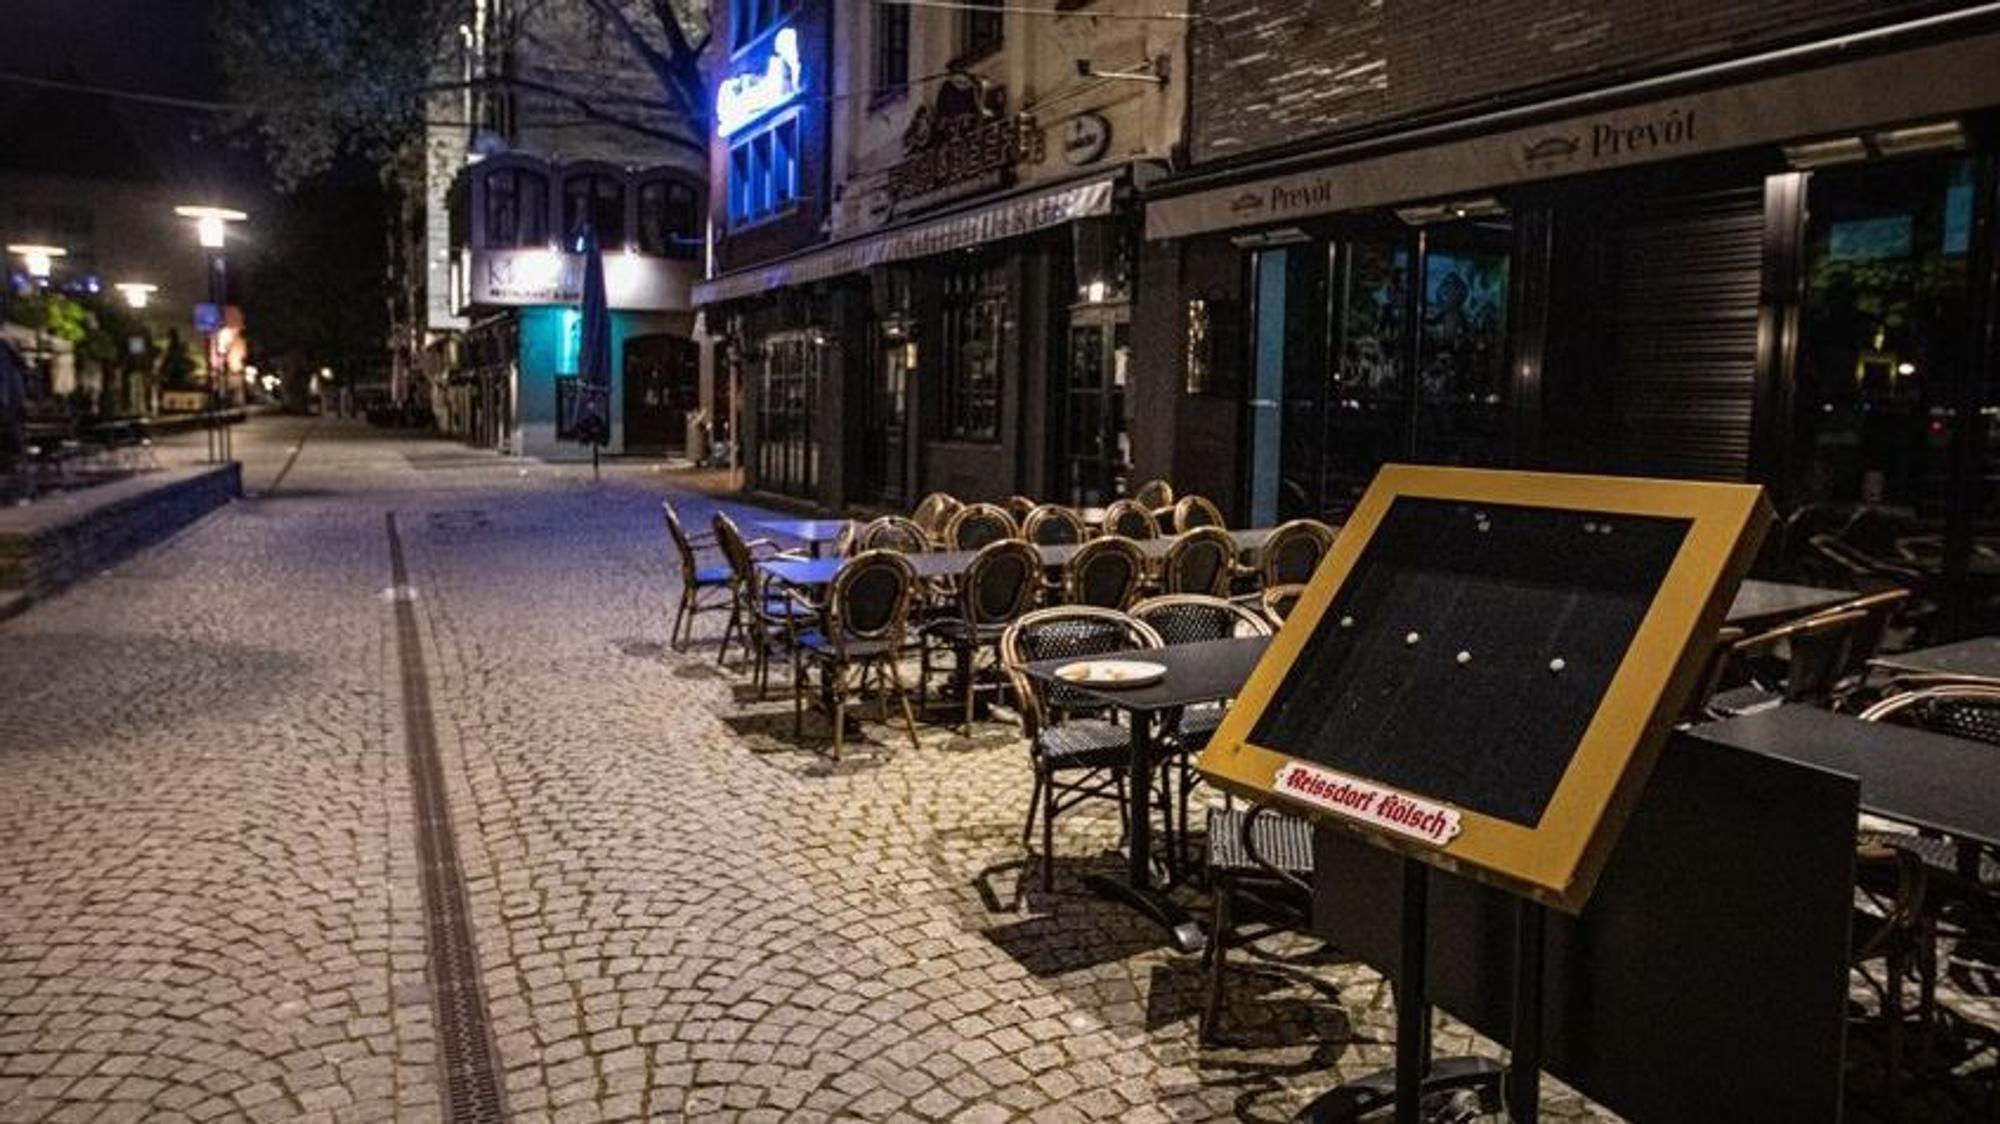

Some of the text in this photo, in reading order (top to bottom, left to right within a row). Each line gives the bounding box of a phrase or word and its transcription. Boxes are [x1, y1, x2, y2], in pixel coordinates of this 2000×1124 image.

[1590, 109, 1696, 158] Prevôt
[1272, 178, 1331, 212] Prevôt
[1287, 768, 1447, 839] Reissdorf Kölsch
